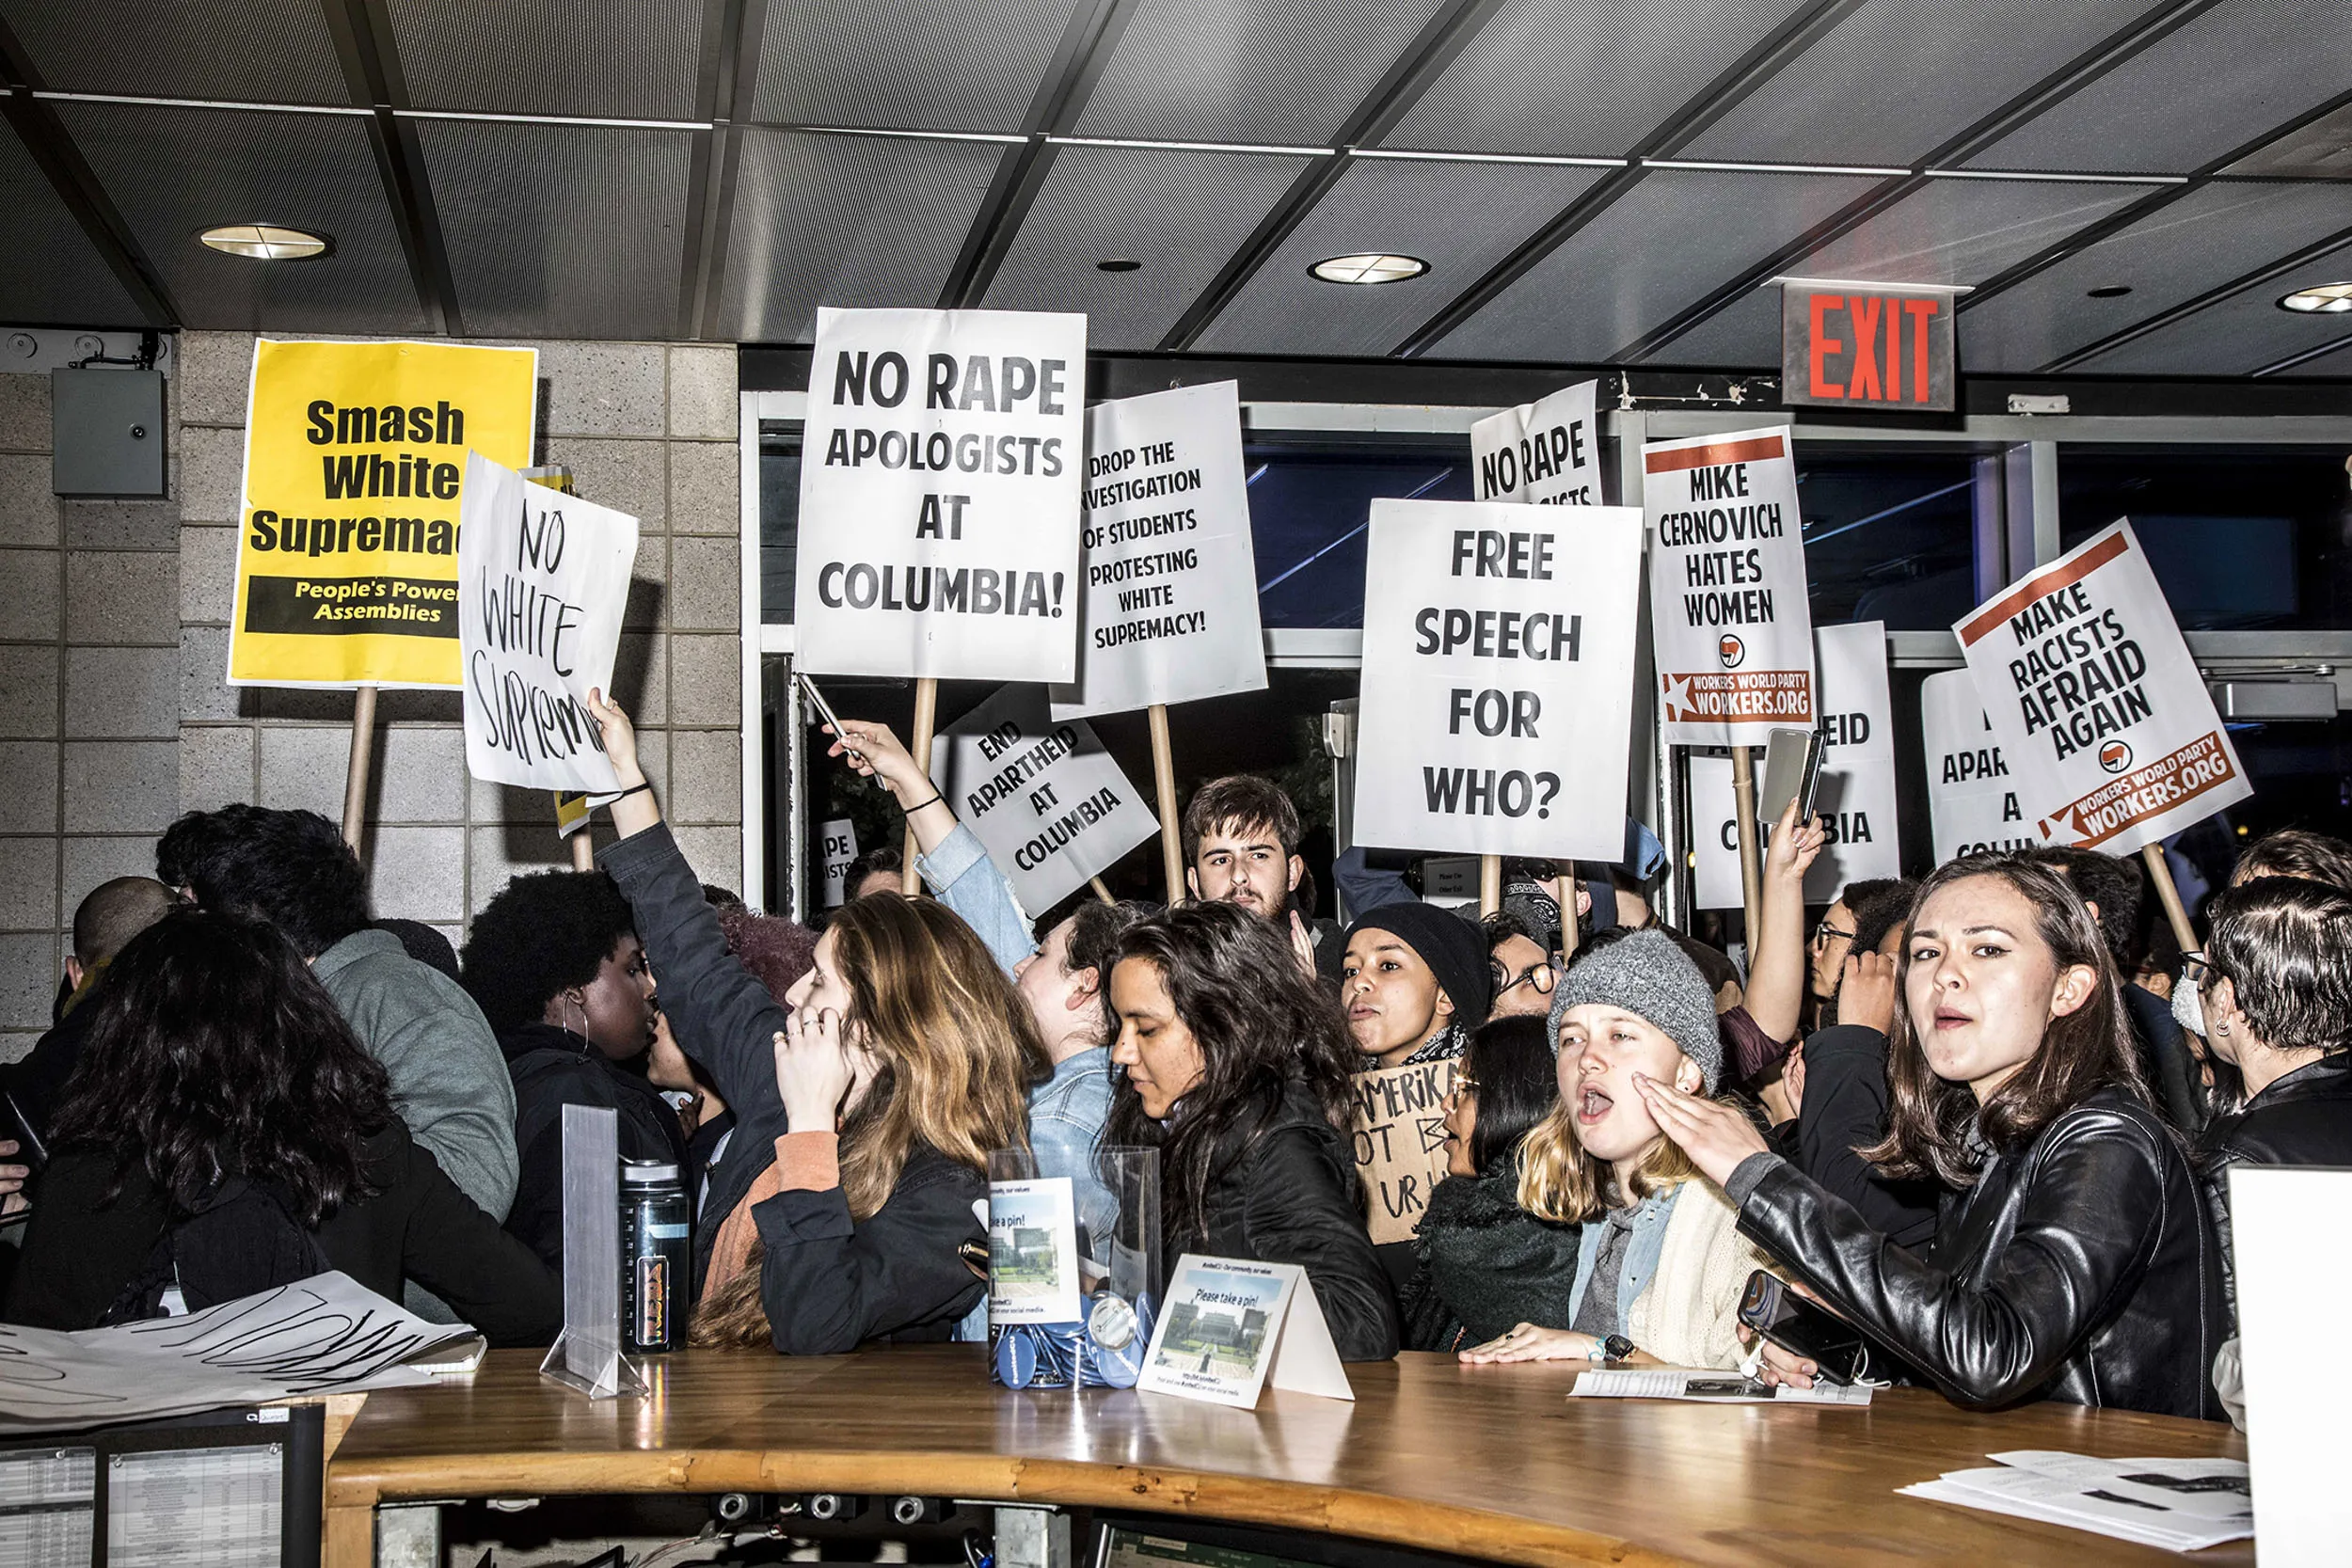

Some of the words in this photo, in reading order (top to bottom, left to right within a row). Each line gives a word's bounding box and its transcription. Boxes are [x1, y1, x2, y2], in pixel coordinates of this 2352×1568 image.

[1809, 294, 1938, 403] EXIT
[834, 351, 908, 409] NO
[927, 354, 1066, 416] RAPE
[307, 400, 464, 446] Smash
[825, 429, 1062, 477] APOLOGISTS
[1089, 449, 1136, 478] DROP
[1140, 441, 1175, 467] THE
[1482, 446, 1517, 499] NO
[1520, 420, 1585, 486] RAPE
[323, 453, 459, 500] White
[1081, 468, 1201, 511] NVESTIGATION
[1690, 463, 1749, 502] MIKE
[250, 510, 461, 557] Suprema
[518, 499, 566, 574] NO
[915, 495, 970, 541] AT
[1082, 527, 1104, 549] OF
[1109, 508, 1198, 545] STUDENTS
[1659, 503, 1784, 548] CERNOVICH
[1089, 547, 1198, 587] PROTESTING
[1452, 530, 1555, 580] FREE
[1686, 547, 1762, 588] HATES
[295, 580, 386, 602] People's
[313, 603, 441, 622] Assemblies
[818, 562, 1064, 619] COLUMBIA!
[1118, 585, 1173, 612] WHITE
[1684, 589, 1774, 627] WOMEN
[483, 570, 583, 677] WHITE
[1094, 611, 1205, 649] SUPREMACY!
[1415, 607, 1582, 662] SPEECH
[2010, 581, 2093, 647] MAKE
[2009, 608, 2124, 693] RACISTS
[1693, 674, 1735, 690] WORKERS
[1737, 673, 1776, 690] WORLD
[1778, 673, 1806, 689] PARTY
[1694, 689, 1808, 715] WORKERS.ORG
[2020, 640, 2147, 736] AFRAID
[1448, 688, 1541, 739] FOR
[1822, 712, 1870, 746] EID
[2051, 683, 2153, 762] AGAIN
[977, 721, 1022, 763] END
[1943, 746, 2010, 784] APAR
[966, 724, 1079, 818] APARTHEID
[1422, 766, 1562, 819] WHO?
[2075, 780, 2132, 816] WORKERS
[2131, 759, 2177, 788] WORLD
[2177, 735, 2217, 764] PARTY
[1029, 782, 1059, 816] AT
[2003, 792, 2023, 822] A
[2081, 751, 2228, 838] WORKERS.ORG
[824, 834, 850, 858] PE
[1014, 786, 1122, 872] COLUMBIA
[1007, 1214, 1025, 1228] pin!
[1195, 1288, 1218, 1302] Please
[1220, 1291, 1235, 1305] take
[1237, 1297, 1243, 1306] a
[1242, 1296, 1259, 1308] pin!
